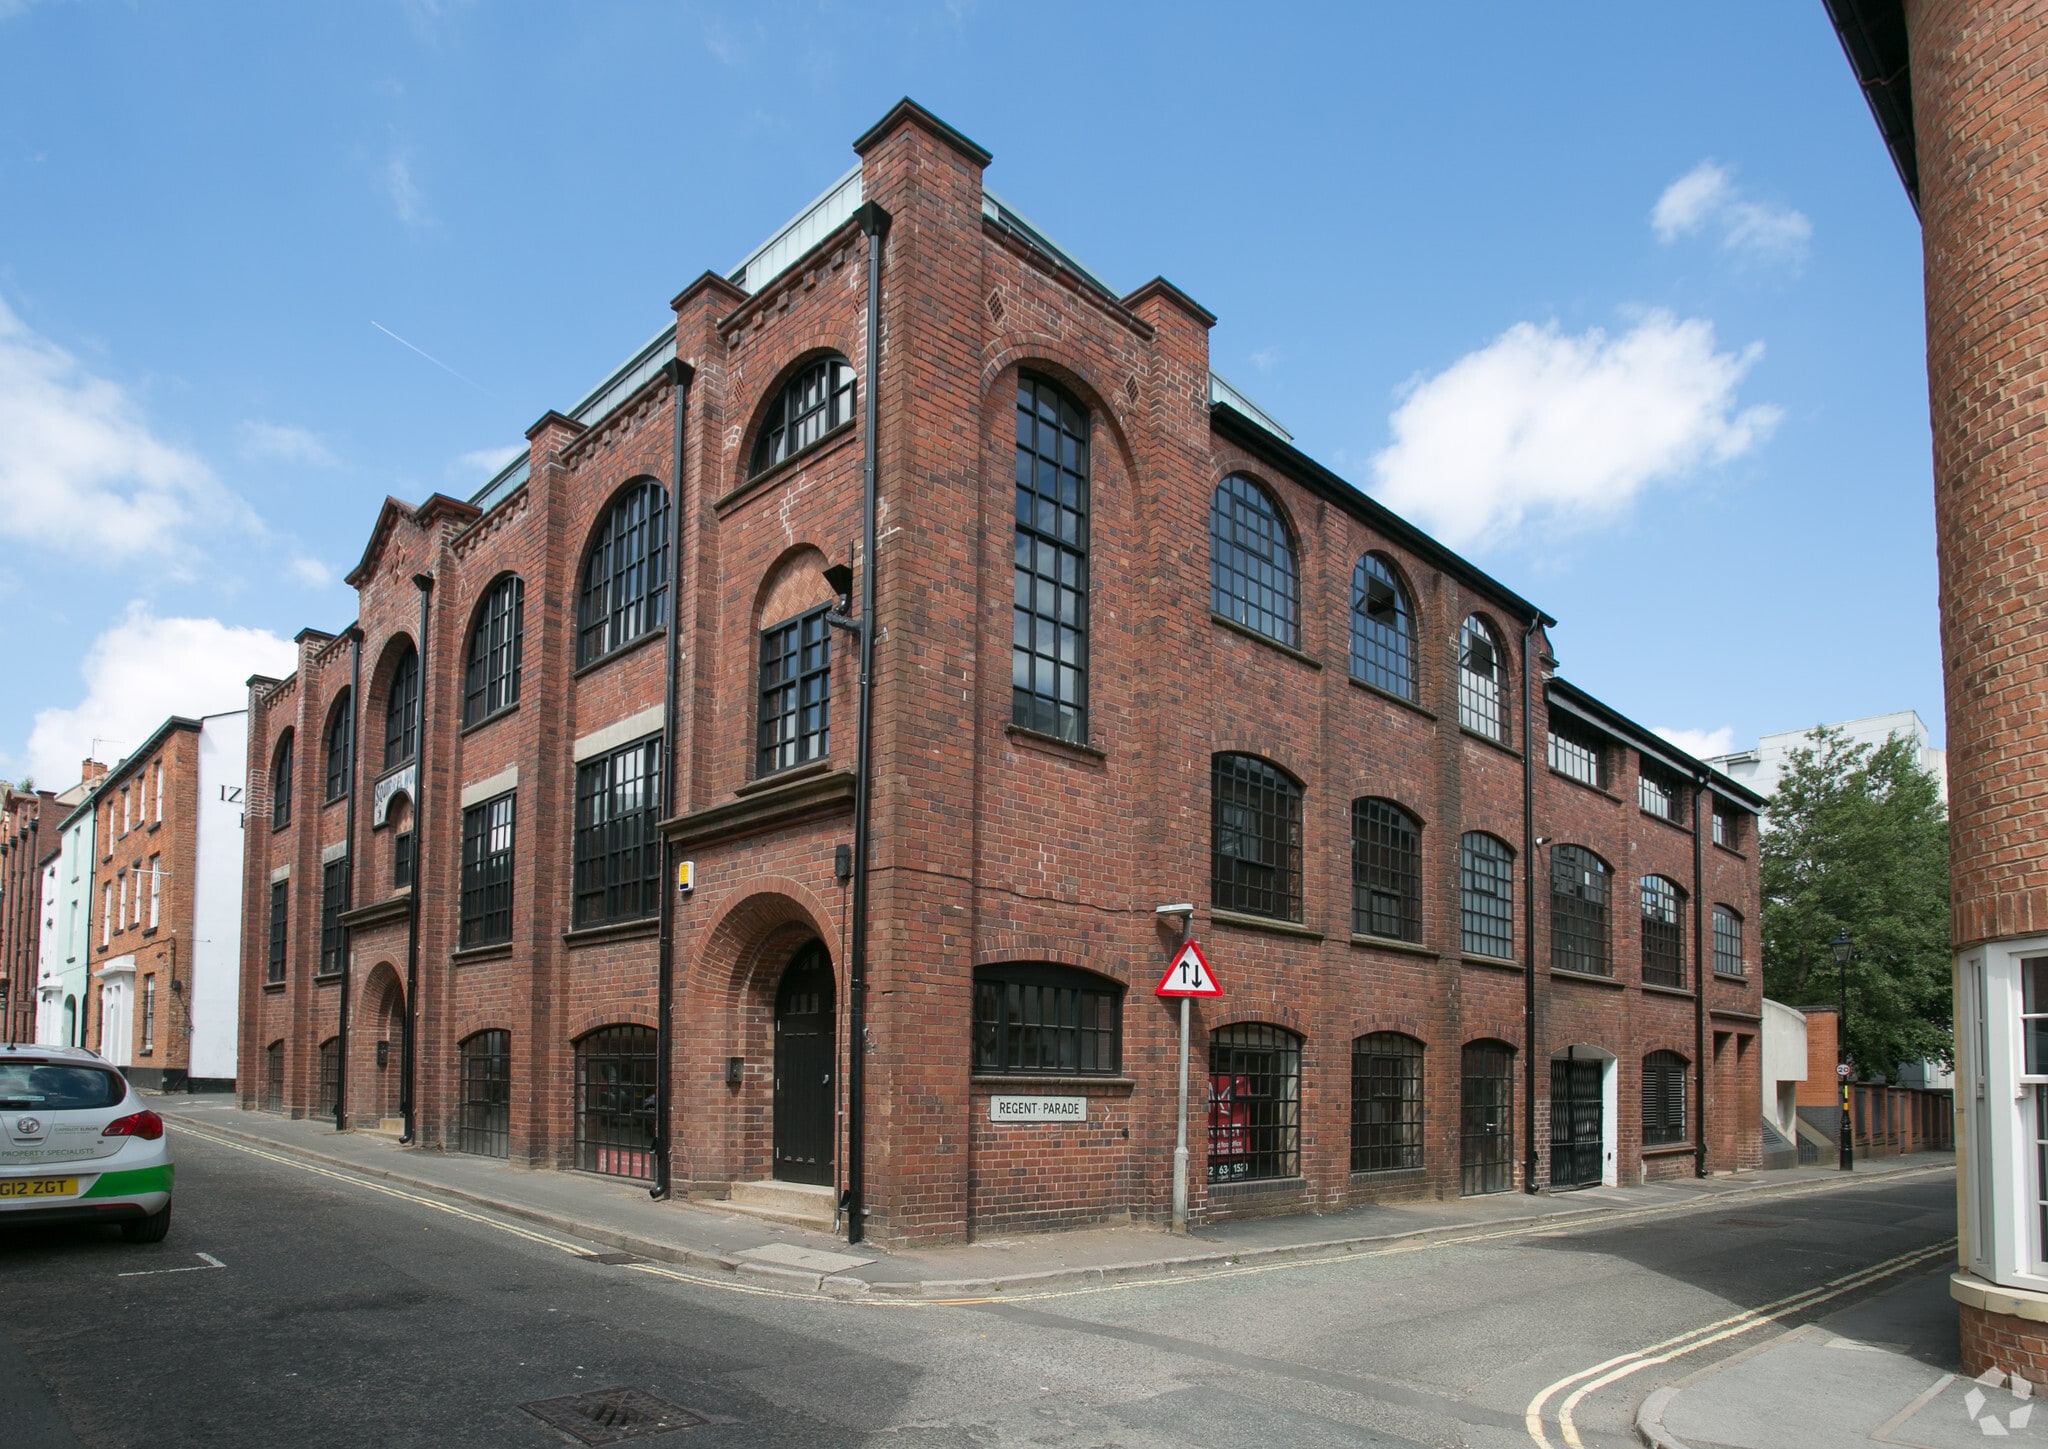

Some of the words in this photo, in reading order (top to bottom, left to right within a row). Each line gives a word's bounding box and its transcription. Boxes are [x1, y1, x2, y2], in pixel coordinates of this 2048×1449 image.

[220, 784, 244, 804] IZ
[999, 1102, 1038, 1114] REGENT
[1043, 1103, 1080, 1115] PARADE
[1, 1150, 45, 1158] PROPERTY
[47, 1147, 95, 1157] SPECIALISTS
[0, 1181, 27, 1196] G12
[33, 1180, 67, 1194] ZGT
